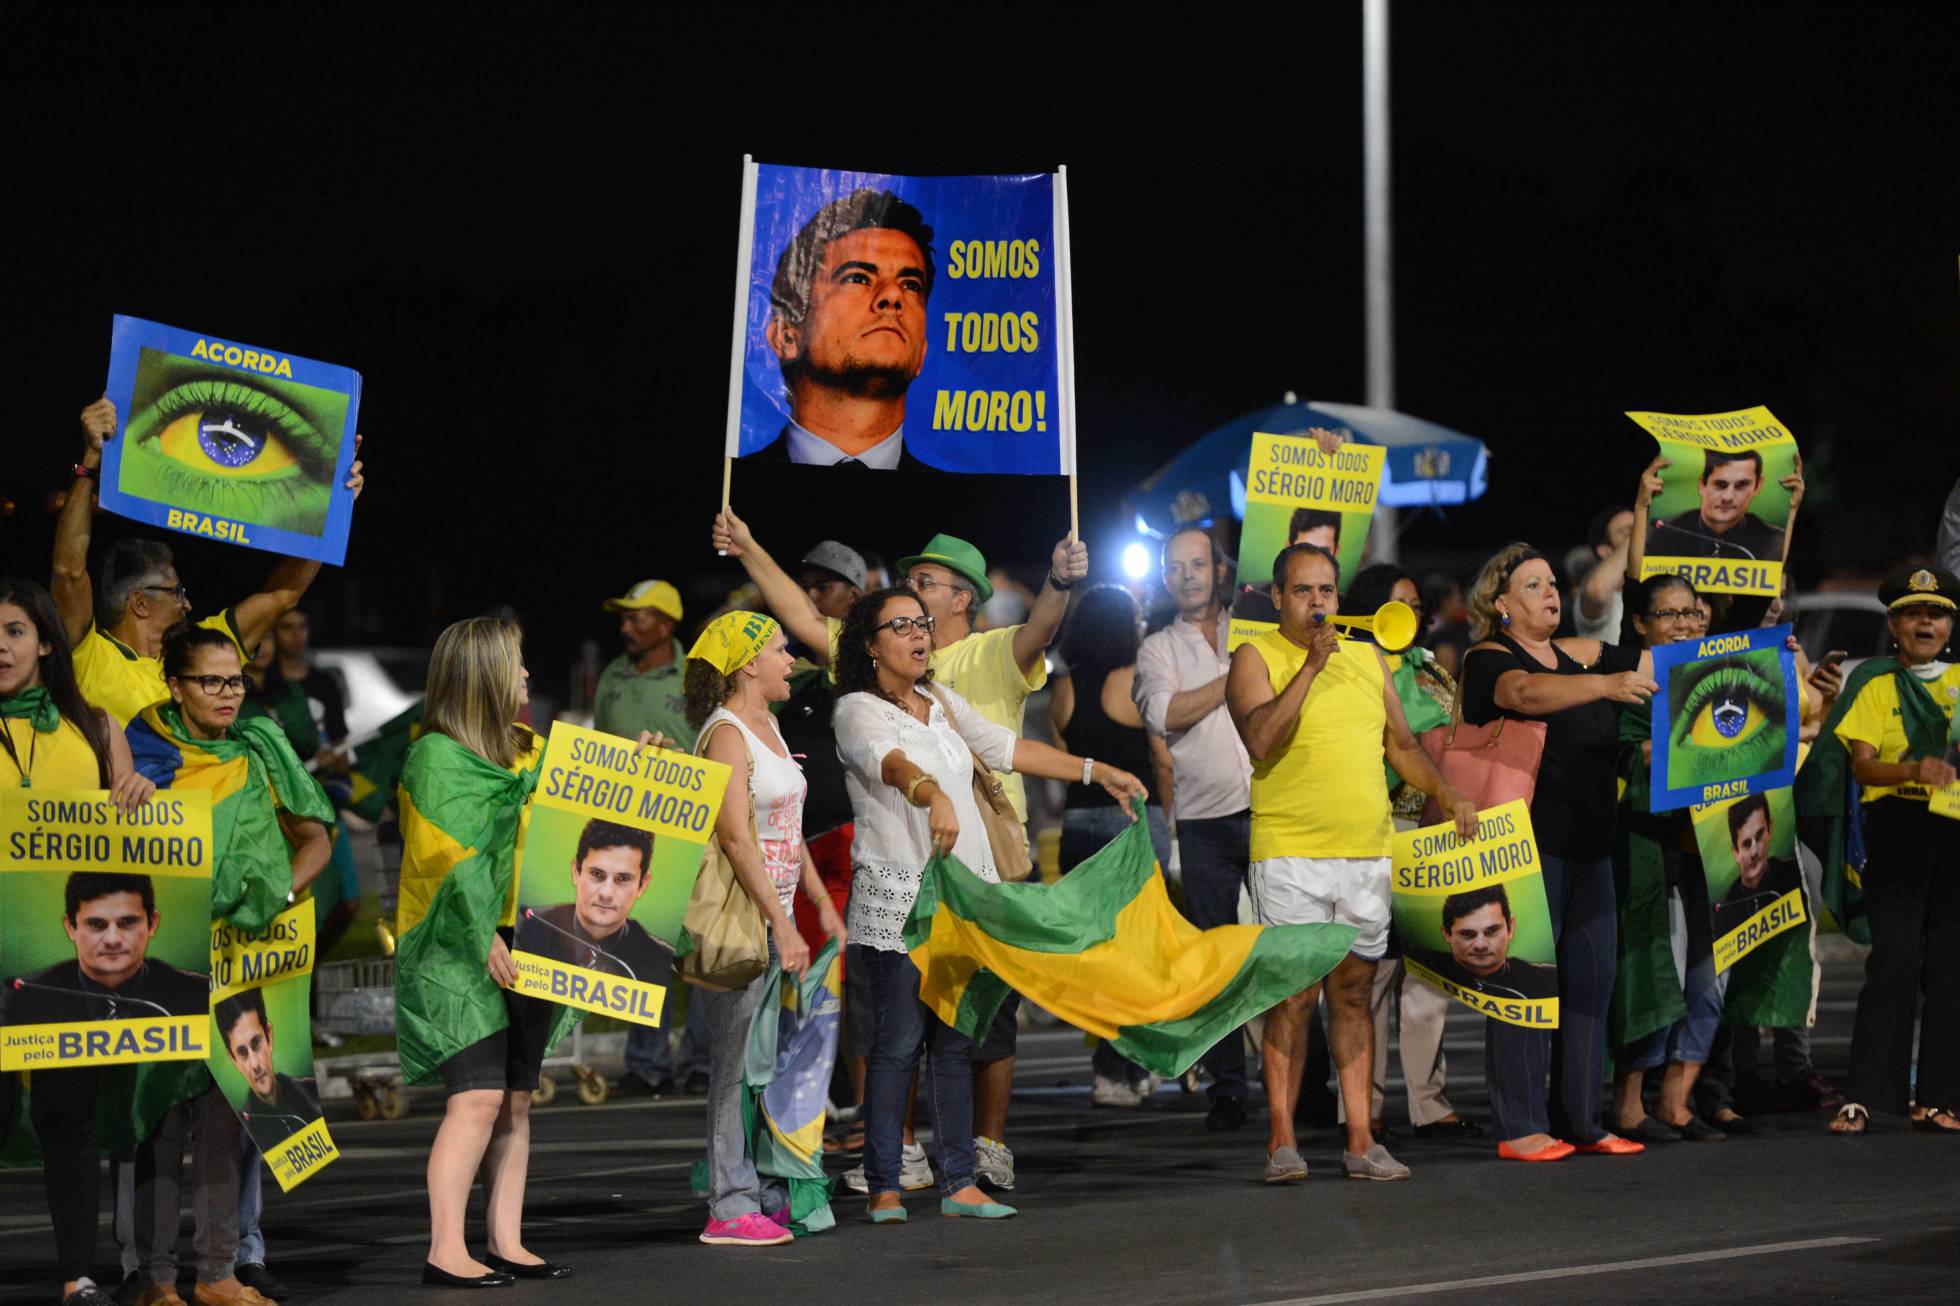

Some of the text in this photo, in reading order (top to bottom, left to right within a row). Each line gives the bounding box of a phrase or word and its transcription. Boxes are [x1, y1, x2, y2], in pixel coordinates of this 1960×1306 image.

[948, 239, 1040, 279] SOMOS
[944, 311, 1039, 353] TODOS
[191, 338, 293, 378] ACORDA
[932, 390, 1047, 432] MORO!
[1702, 415, 1755, 430] TODOS
[1720, 425, 1783, 448] MORO
[1270, 443, 1325, 468] SOMOS
[1254, 467, 1374, 505] SÉRGIO MORO
[167, 509, 250, 544] BRASIL
[1677, 564, 1775, 590] BRASIL
[1232, 626, 1262, 636] Justi
[1698, 634, 1750, 659] ACORDA
[570, 737, 706, 792] SOMOS TODOS
[546, 766, 710, 832] SÉRGIO MORO
[1704, 780, 1749, 801] BRASIL
[27, 800, 108, 824] SOMOS
[1472, 813, 1515, 844] ODOS
[10, 826, 202, 866] SÉRGIO MORO
[1398, 839, 1533, 888] SÉRGIO MORO
[1737, 900, 1800, 953] BRASIL
[242, 944, 308, 983] MORO
[515, 959, 550, 977] Justiça
[524, 978, 549, 991] pelo
[551, 968, 655, 1019] BRASIL
[1442, 981, 1552, 1024] BRASIL
[4, 1033, 55, 1047] Justiça
[23, 1049, 55, 1062] pelo
[59, 1025, 202, 1059] BRASIL
[285, 1130, 333, 1173] BRASIL
